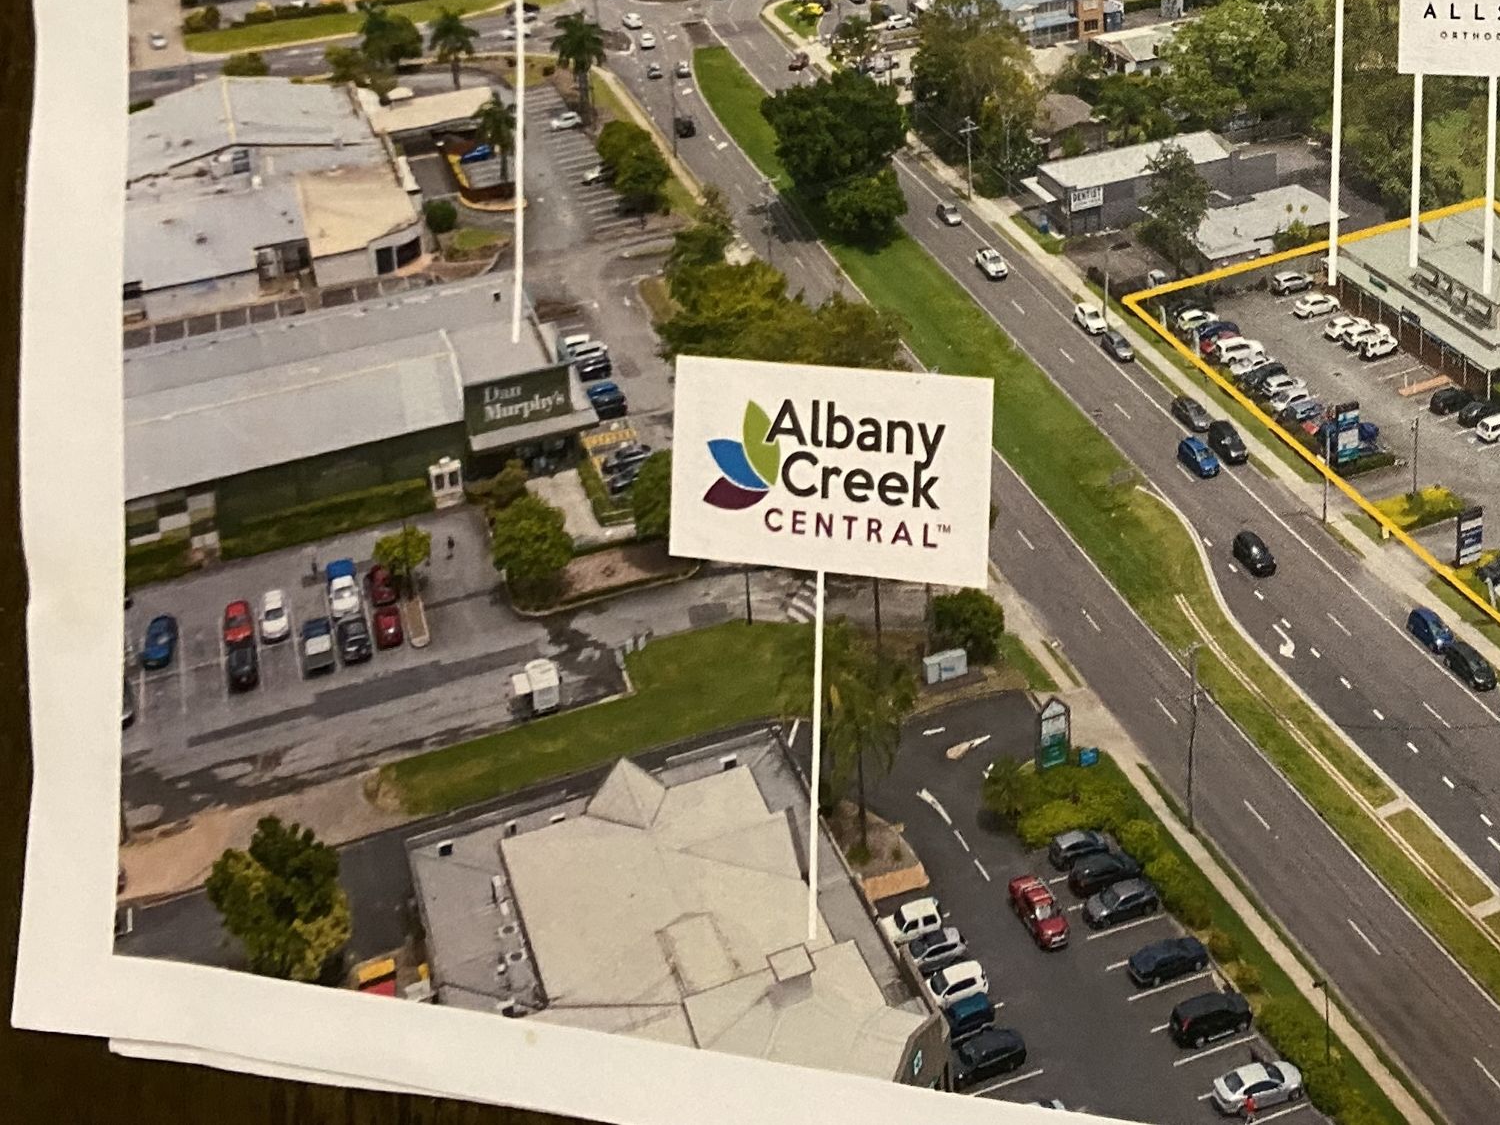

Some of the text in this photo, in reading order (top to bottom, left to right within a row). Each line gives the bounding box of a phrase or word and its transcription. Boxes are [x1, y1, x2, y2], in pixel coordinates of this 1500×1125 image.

[483, 391, 565, 422] Murphy's
[484, 385, 522, 403] Dan
[765, 398, 947, 470] Albany
[781, 450, 940, 510] Creek
